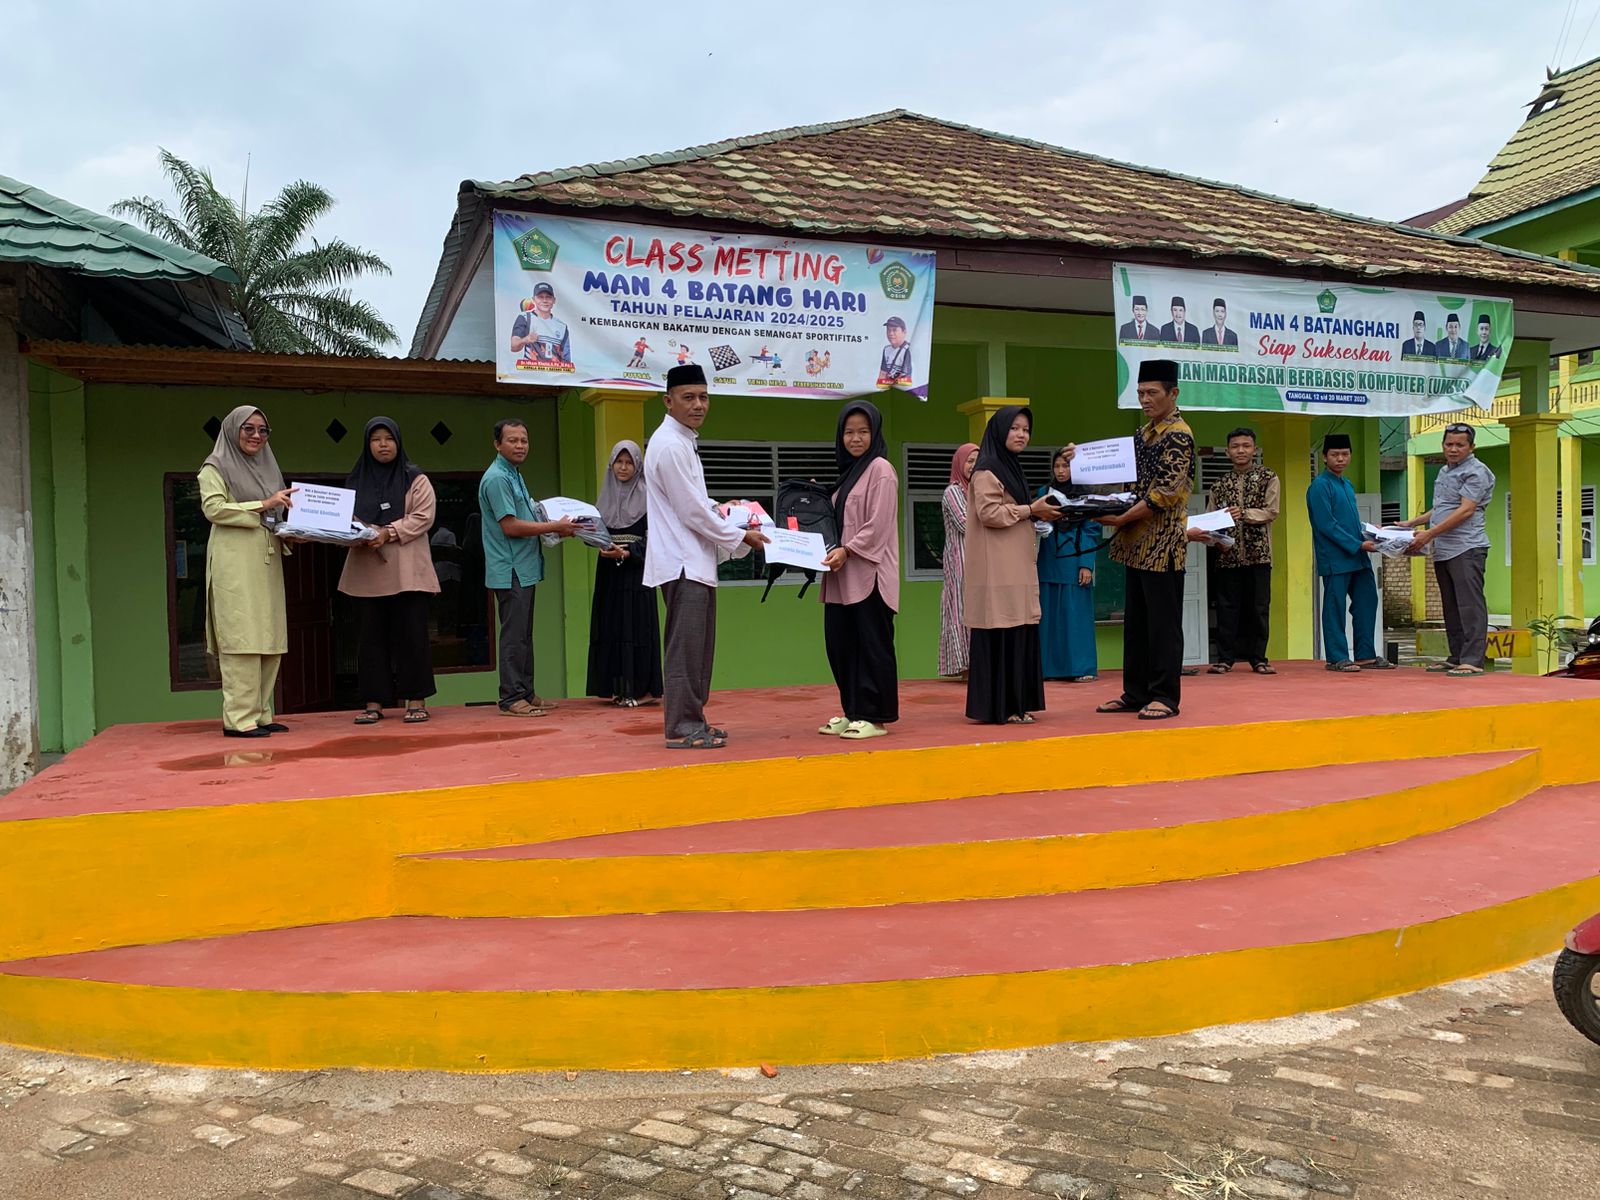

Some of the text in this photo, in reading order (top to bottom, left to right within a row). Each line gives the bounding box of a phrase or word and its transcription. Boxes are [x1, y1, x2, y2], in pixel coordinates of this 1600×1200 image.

[605, 235, 844, 285] CLASS METTING
[583, 271, 866, 312] MAN 4 BATANG HARI
[611, 300, 844, 328] TAHUN PELAJARAN 2024/2025
[1250, 312, 1400, 339] MAN 4 BATANGHARI
[589, 317, 660, 331] KEMBANGKAN
[663, 320, 709, 334] BAKATMU
[712, 326, 751, 336] DENGAN
[754, 330, 803, 340] SEMANGAT
[805, 333, 862, 343] SPORTIFITAS
[1258, 335, 1392, 364] Siap Sukseskan
[623, 372, 652, 380] FUTSAL
[713, 376, 737, 384] CATUR
[747, 378, 787, 387] TENIS MEJA
[1206, 363, 1284, 386] MADRASAH
[1289, 369, 1355, 389] BERBASIS
[1359, 373, 1425, 393] KOMPUTER
[1288, 392, 1312, 400] TANGGAL
[1336, 394, 1353, 402] MARET
[1353, 395, 1366, 403] 2025
